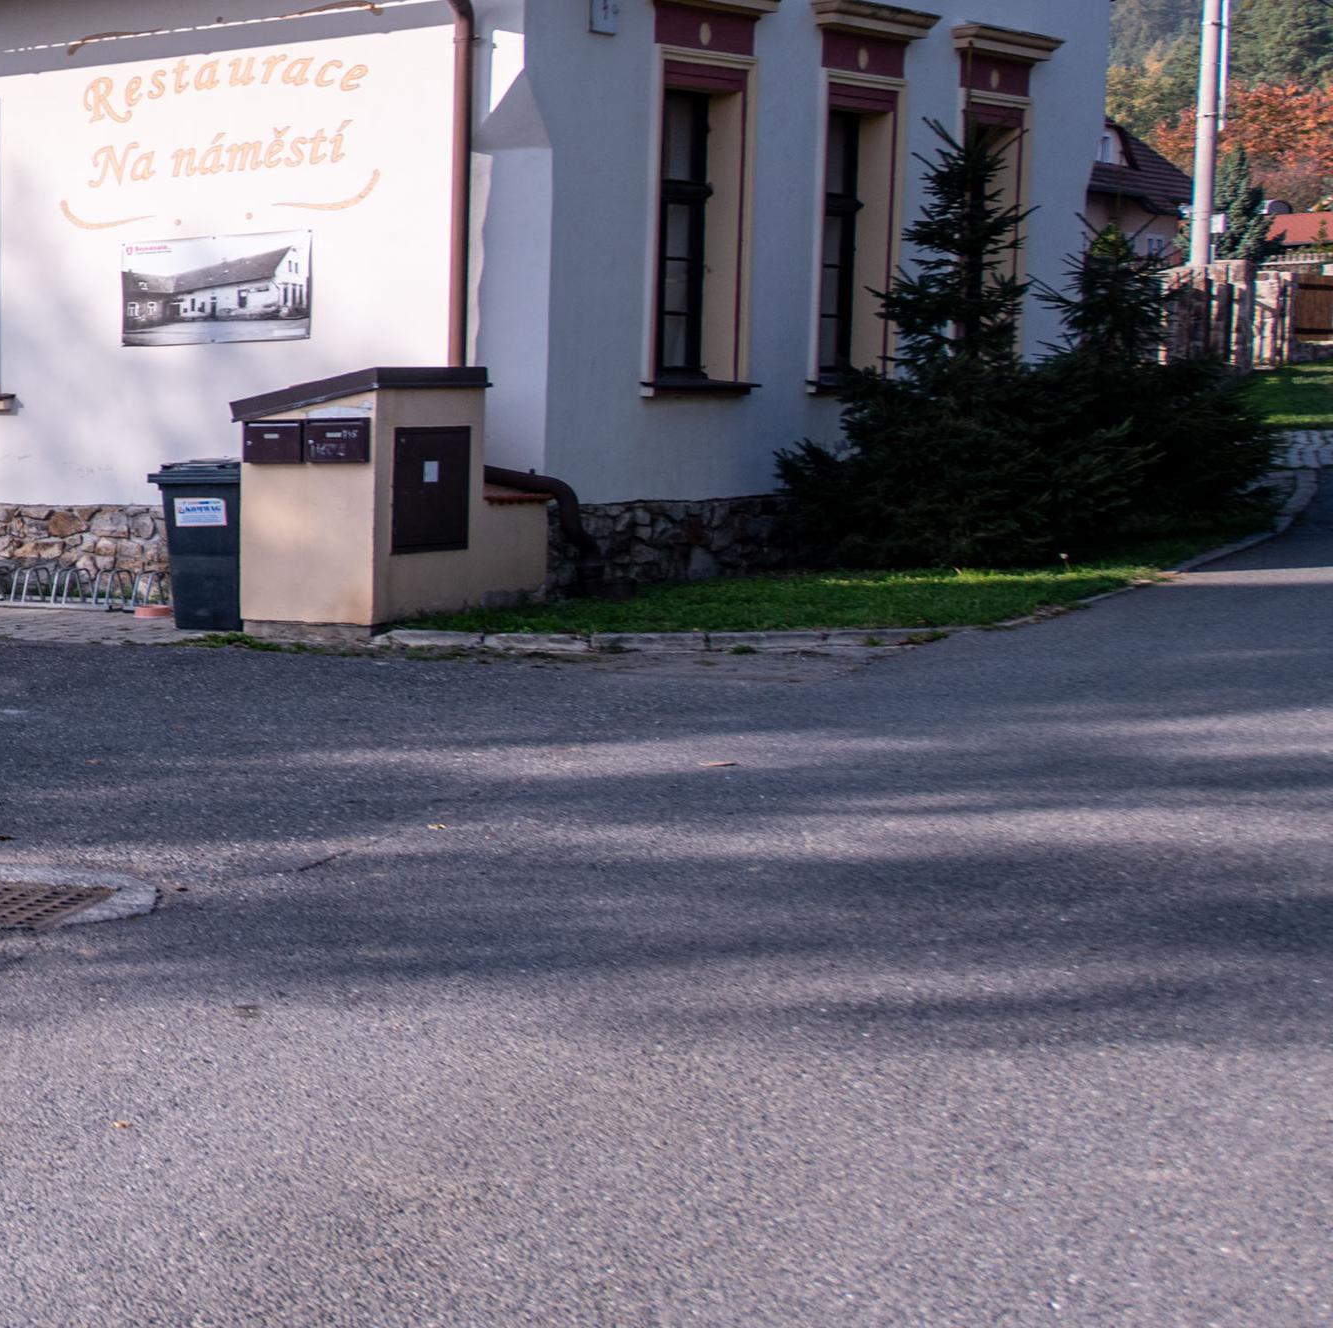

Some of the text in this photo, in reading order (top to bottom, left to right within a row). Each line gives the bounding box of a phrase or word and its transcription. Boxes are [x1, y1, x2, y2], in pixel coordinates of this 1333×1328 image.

[83, 53, 370, 123] Restaurace
[87, 118, 354, 189] Na náměstí
